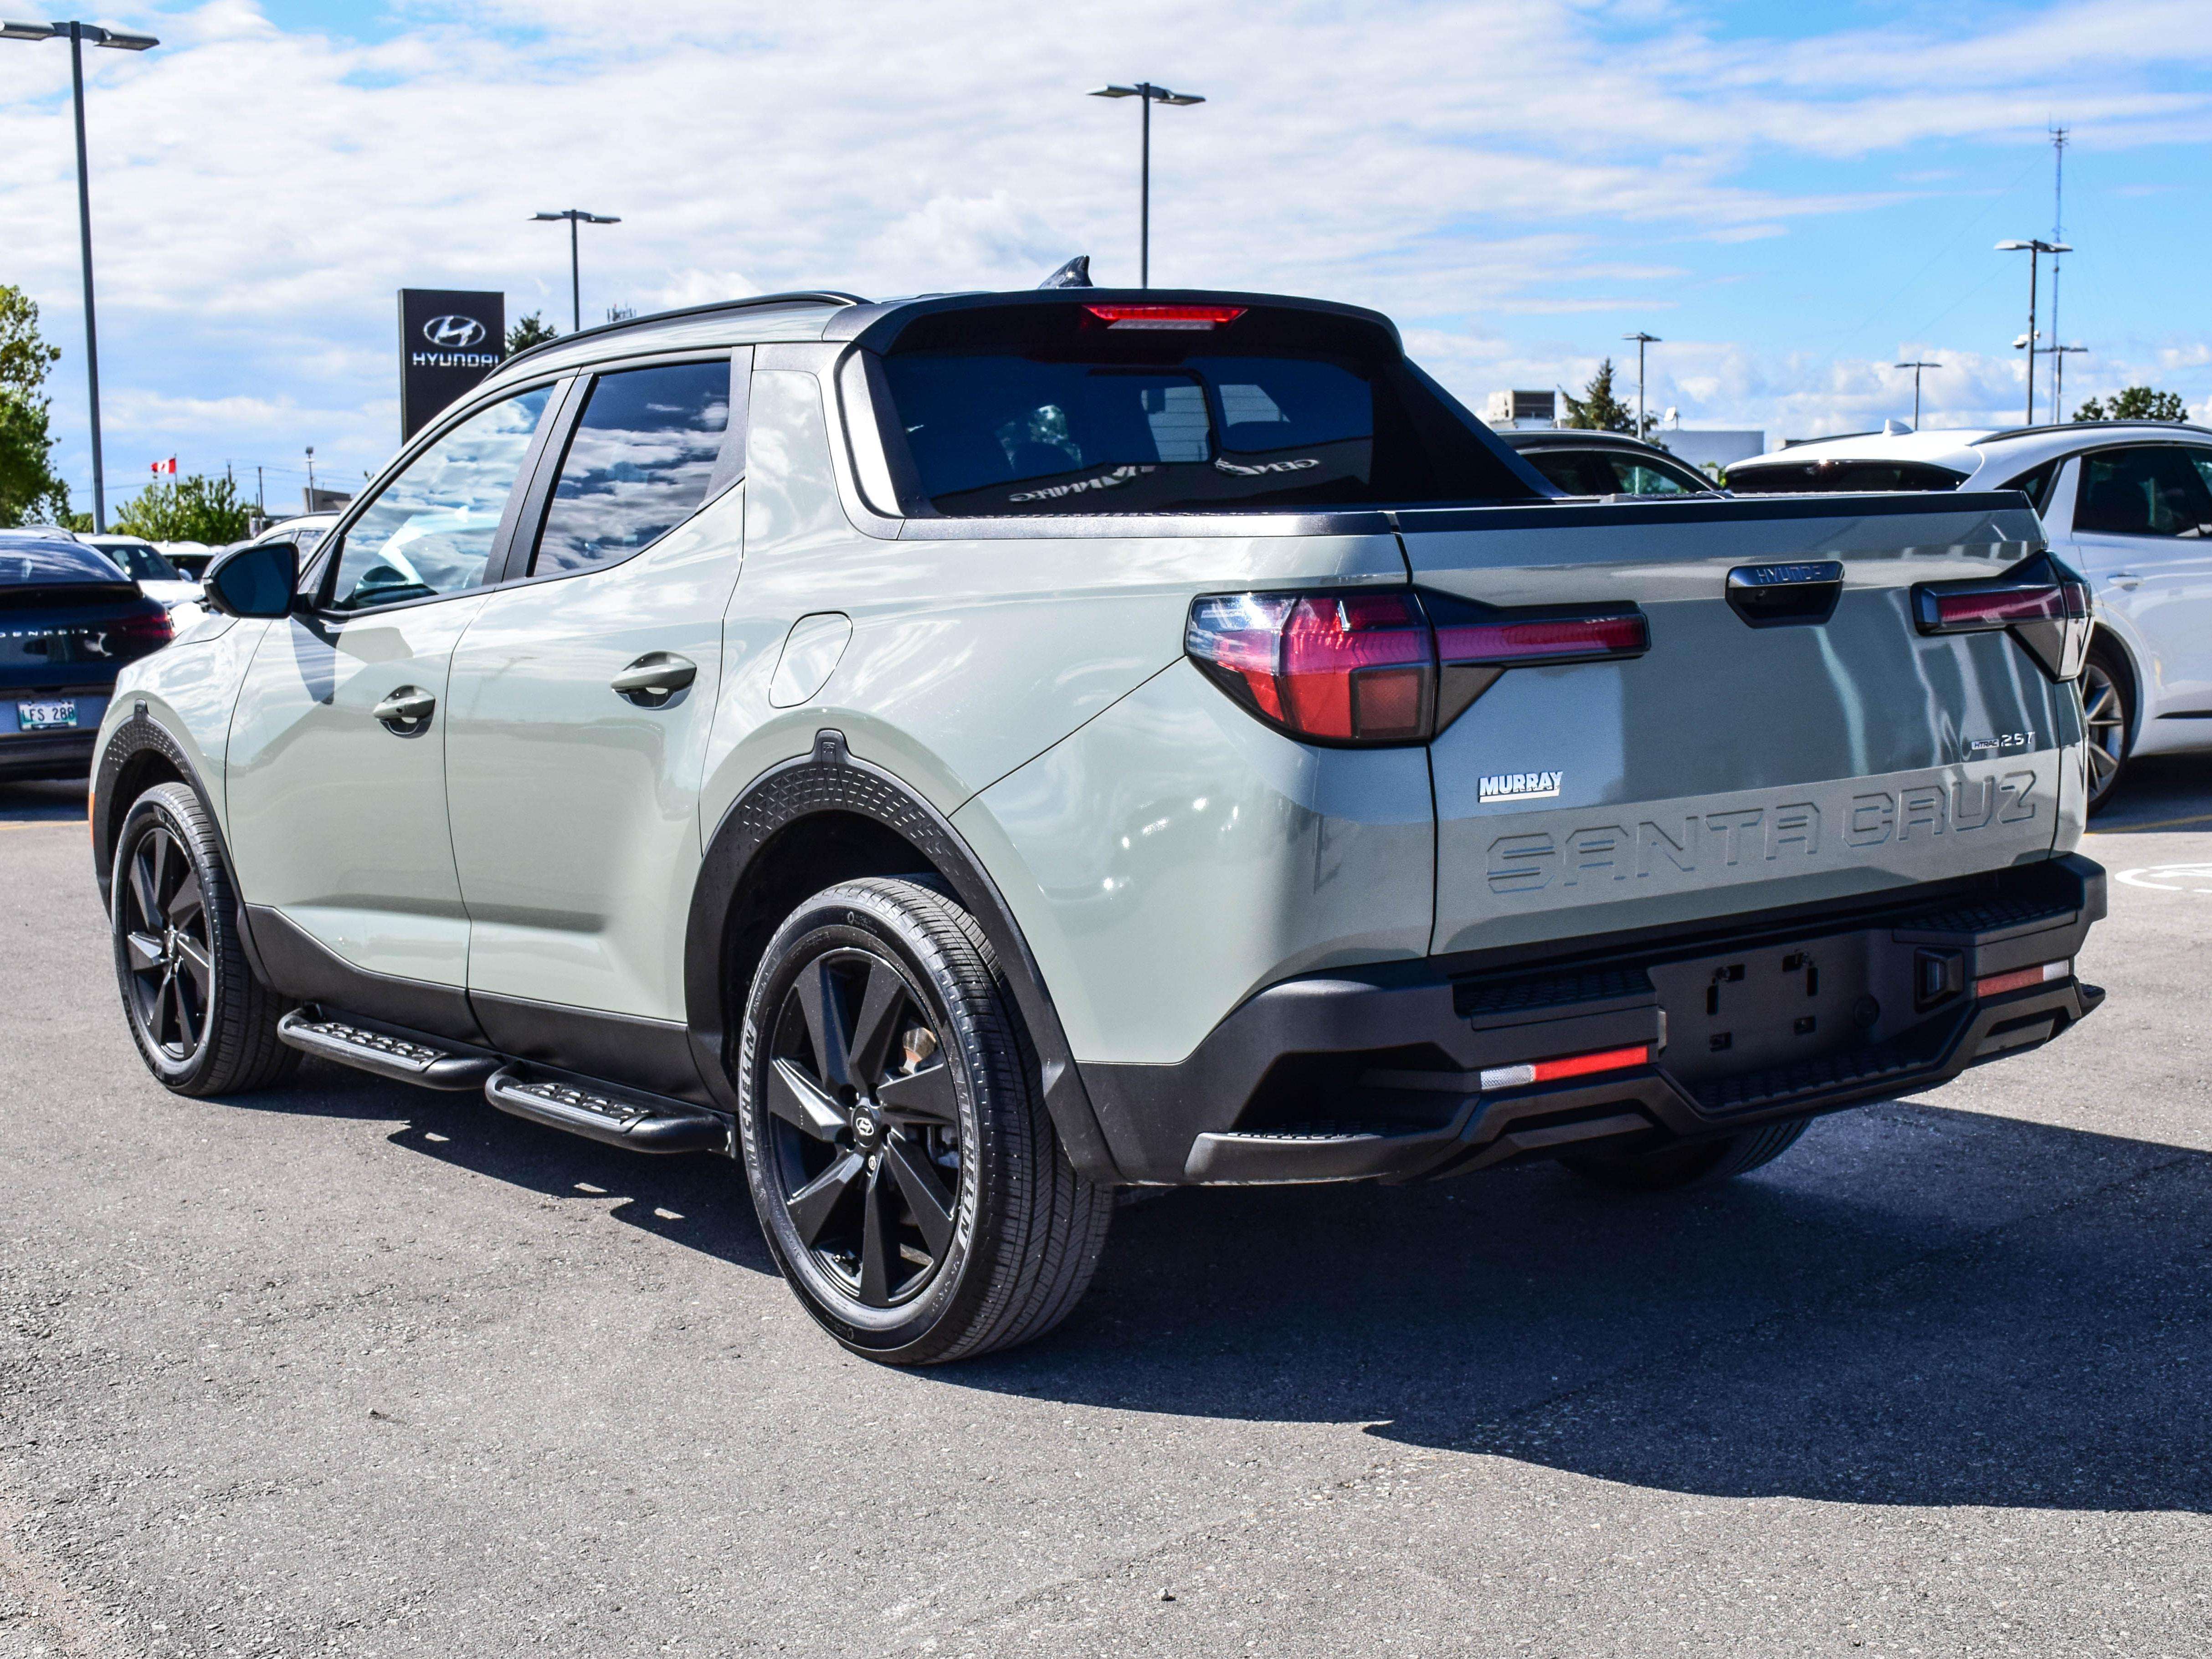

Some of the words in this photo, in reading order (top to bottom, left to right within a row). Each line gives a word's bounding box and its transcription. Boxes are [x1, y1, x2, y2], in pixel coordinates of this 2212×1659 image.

[413, 352, 499, 367] HYUNDAI
[1756, 565, 1828, 583] HYUNDA
[1974, 740, 1997, 748] HTRAC
[1480, 771, 1563, 796] MURRAY
[1486, 802, 1821, 894] SANTA
[1843, 770, 2037, 847] CRUZ
[741, 1029, 757, 1171] MICHELIN
[958, 1083, 975, 1238] MICHELIN
